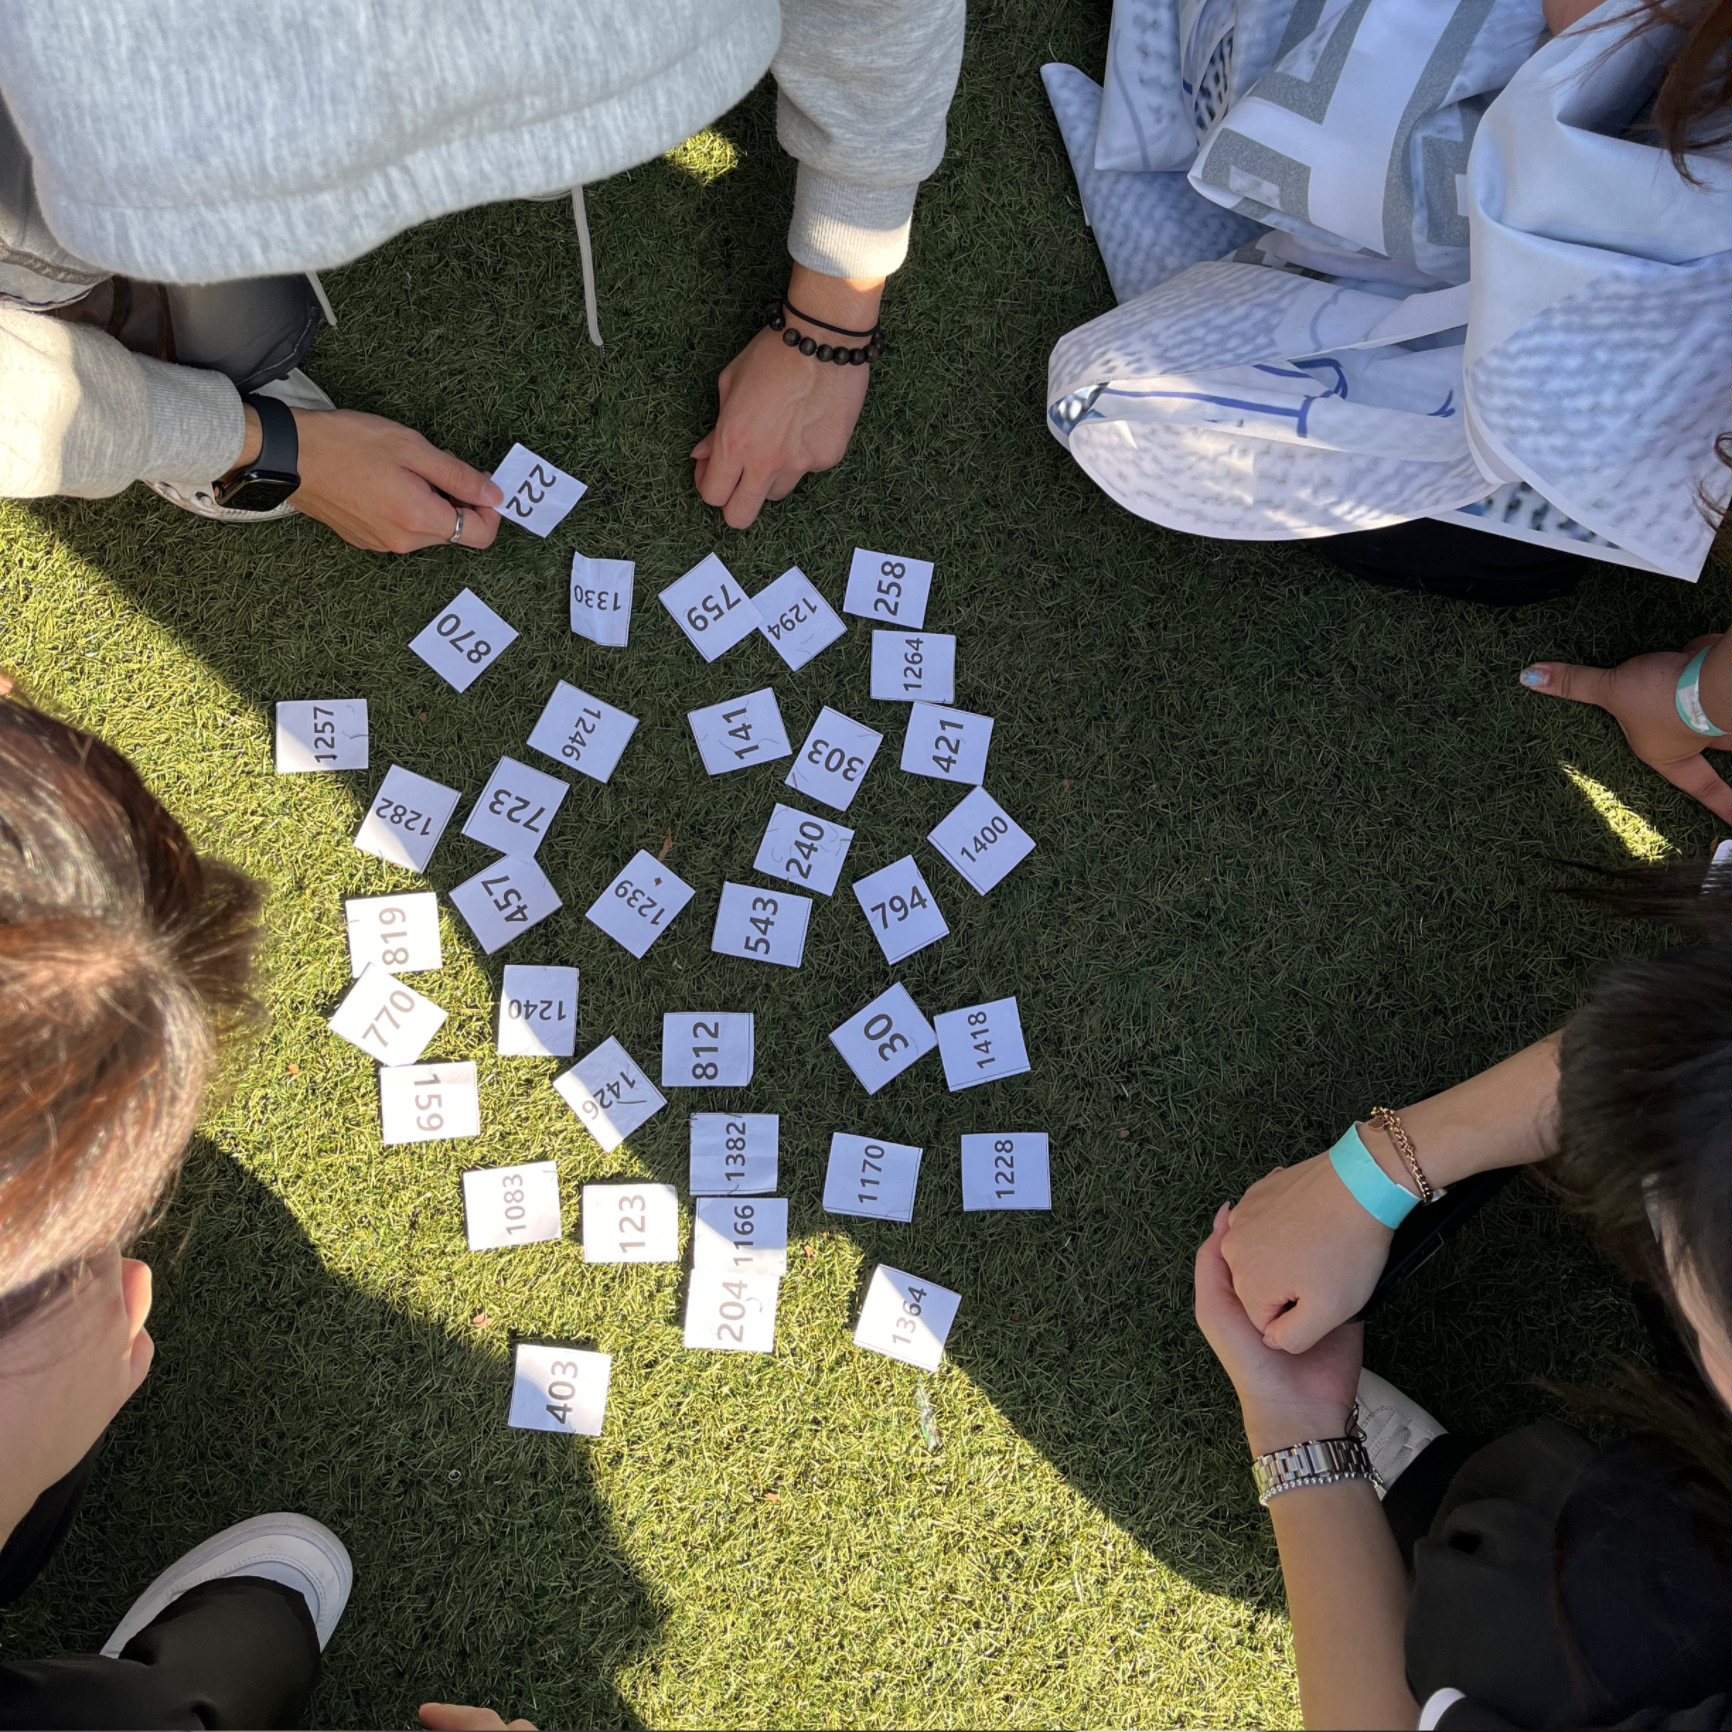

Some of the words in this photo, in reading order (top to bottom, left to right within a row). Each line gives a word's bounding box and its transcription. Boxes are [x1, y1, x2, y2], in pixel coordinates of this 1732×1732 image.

[506, 464, 556, 518] 222
[574, 584, 621, 612] 1330
[687, 584, 741, 632] 759
[874, 561, 906, 616] 258
[436, 613, 492, 664] 870
[767, 597, 817, 641] 1294
[903, 637, 924, 691] 1264
[313, 706, 336, 763] 1257
[561, 706, 602, 761] 1246
[722, 707, 760, 760] 141
[807, 739, 865, 782] 303
[932, 719, 965, 773] 421
[375, 797, 433, 837] 1282
[488, 788, 546, 833] 723
[786, 821, 824, 879] 240
[960, 815, 1009, 864] 1400
[481, 874, 529, 925] 457
[614, 879, 664, 926] 1239
[744, 897, 778, 955] 543
[871, 885, 928, 930] 794
[378, 906, 410, 966] 819
[361, 990, 415, 1049] 770
[507, 999, 567, 1022] 1240
[863, 1013, 910, 1062] 30
[691, 1021, 719, 1080] 812
[967, 1010, 996, 1069] 1418
[413, 1073, 444, 1132] 159
[582, 1070, 637, 1121] 1426
[725, 1121, 747, 1182] 1382
[858, 1144, 885, 1204] 1170
[994, 1139, 1015, 1199] 1228
[503, 1172, 527, 1236] 1083
[618, 1193, 646, 1254] 123
[733, 1204, 755, 1266] 1166
[716, 1280, 748, 1343] 204
[892, 1286, 928, 1345] 1364
[545, 1359, 579, 1425] 403
